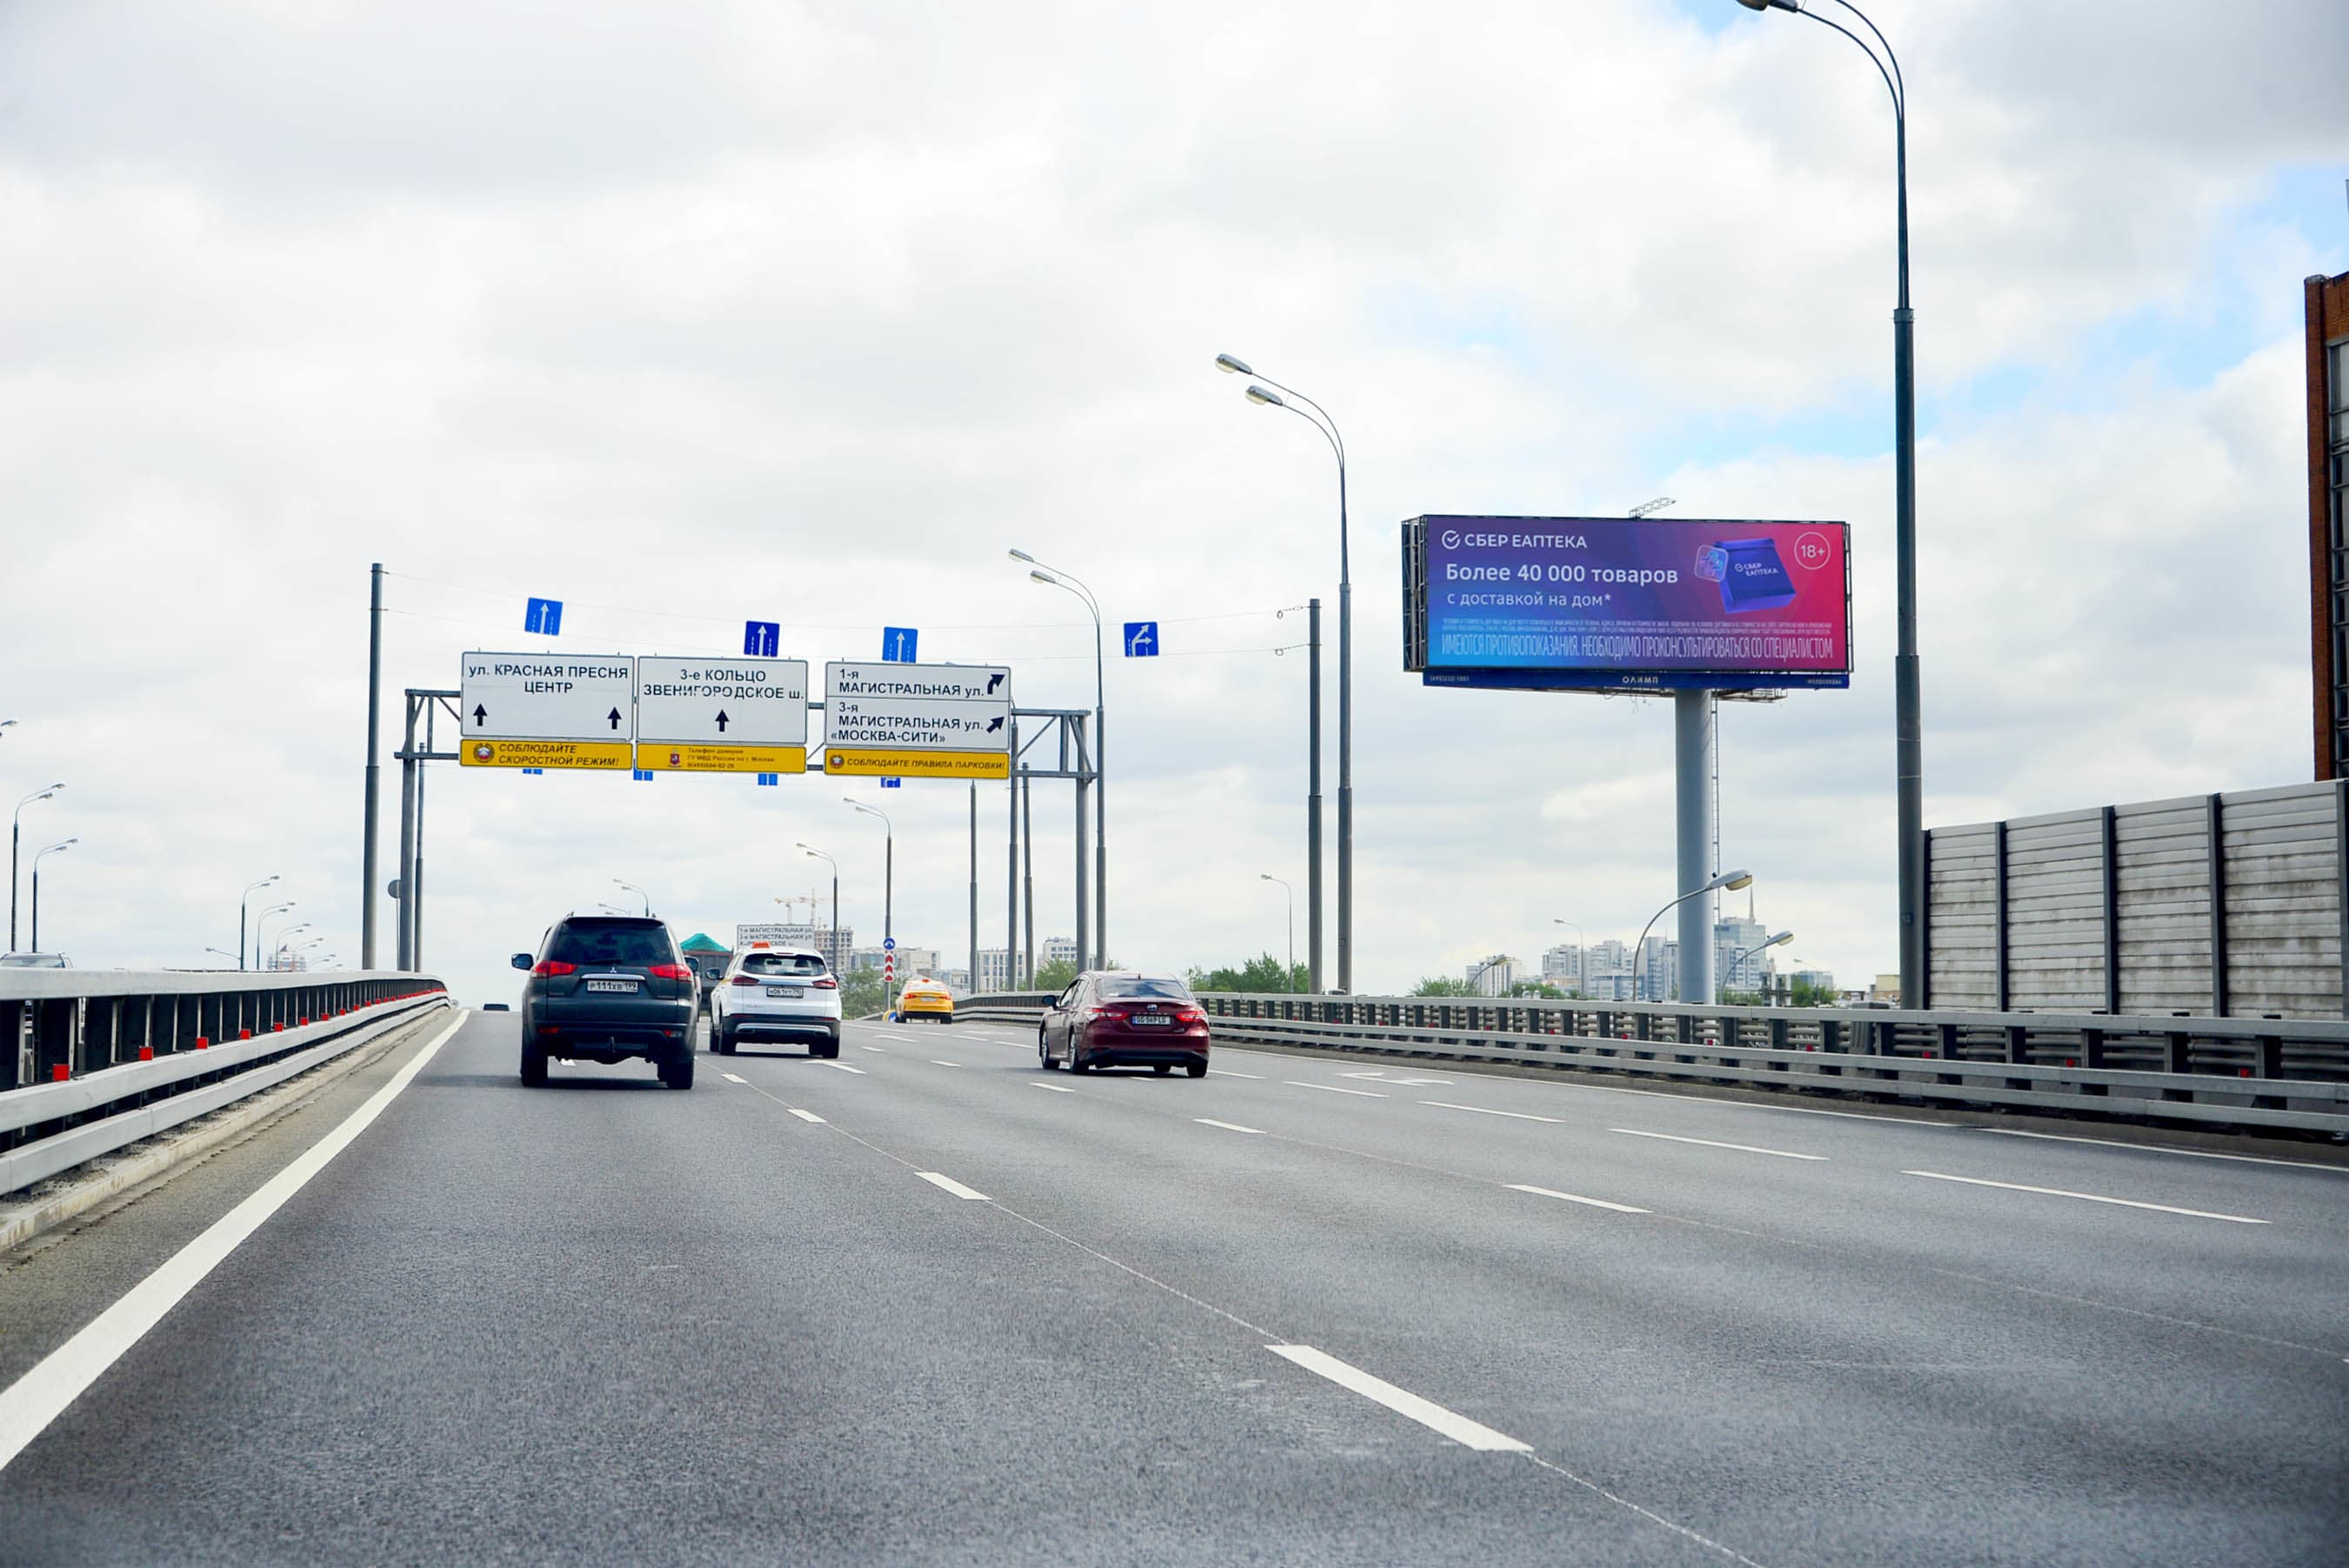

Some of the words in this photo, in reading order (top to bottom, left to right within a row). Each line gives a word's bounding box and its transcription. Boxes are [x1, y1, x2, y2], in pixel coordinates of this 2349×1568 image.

[1465, 533, 1508, 547] СБЕР
[1512, 535, 1588, 549] ЕАПТЕКА
[1800, 544, 1825, 558] 18+
[1446, 564, 1511, 581] Более
[1517, 564, 1542, 582] 40
[1548, 565, 1585, 583] 000
[1591, 568, 1678, 586] товаров
[1447, 593, 1455, 604] с
[1460, 591, 1544, 607] доставкой
[1549, 594, 1567, 605] на
[1441, 633, 1484, 656] ИМЕЮТСЯ
[1582, 636, 1641, 661] НЕОБХОДИМО
[1751, 637, 1762, 658] СО
[469, 665, 490, 677] ул.
[495, 664, 564, 677] КРАСНАЯ
[568, 666, 628, 678] ПРЕСНЯ
[680, 669, 701, 681] 3-е
[705, 670, 766, 684] КОЛЬЦО
[839, 668, 859, 679] 1-я
[524, 682, 573, 694] ЦЕНТР
[644, 684, 784, 700] ЗВЕНИГОРОДСКОЕ
[789, 691, 804, 700] ш.
[839, 682, 961, 696] МАГИСТРАЛЬНАЯ
[964, 687, 984, 699] ул.
[838, 702, 858, 713] 3-я
[838, 716, 960, 730] МАГИСТРАЛЬНАЯ
[964, 721, 984, 732] ул.
[831, 731, 945, 744] «МОСКВА-СИТИ»
[499, 744, 577, 753] СОБЛЮДАЙТЕ
[499, 755, 573, 766] СКОРОСТНОЙ
[577, 757, 619, 766] РЕЖИМ!
[847, 757, 910, 768] СОБЛЮДАЙТЕ
[911, 759, 953, 769] ПРАВИЛА
[955, 761, 1004, 771] ПАРКОВКИ!
